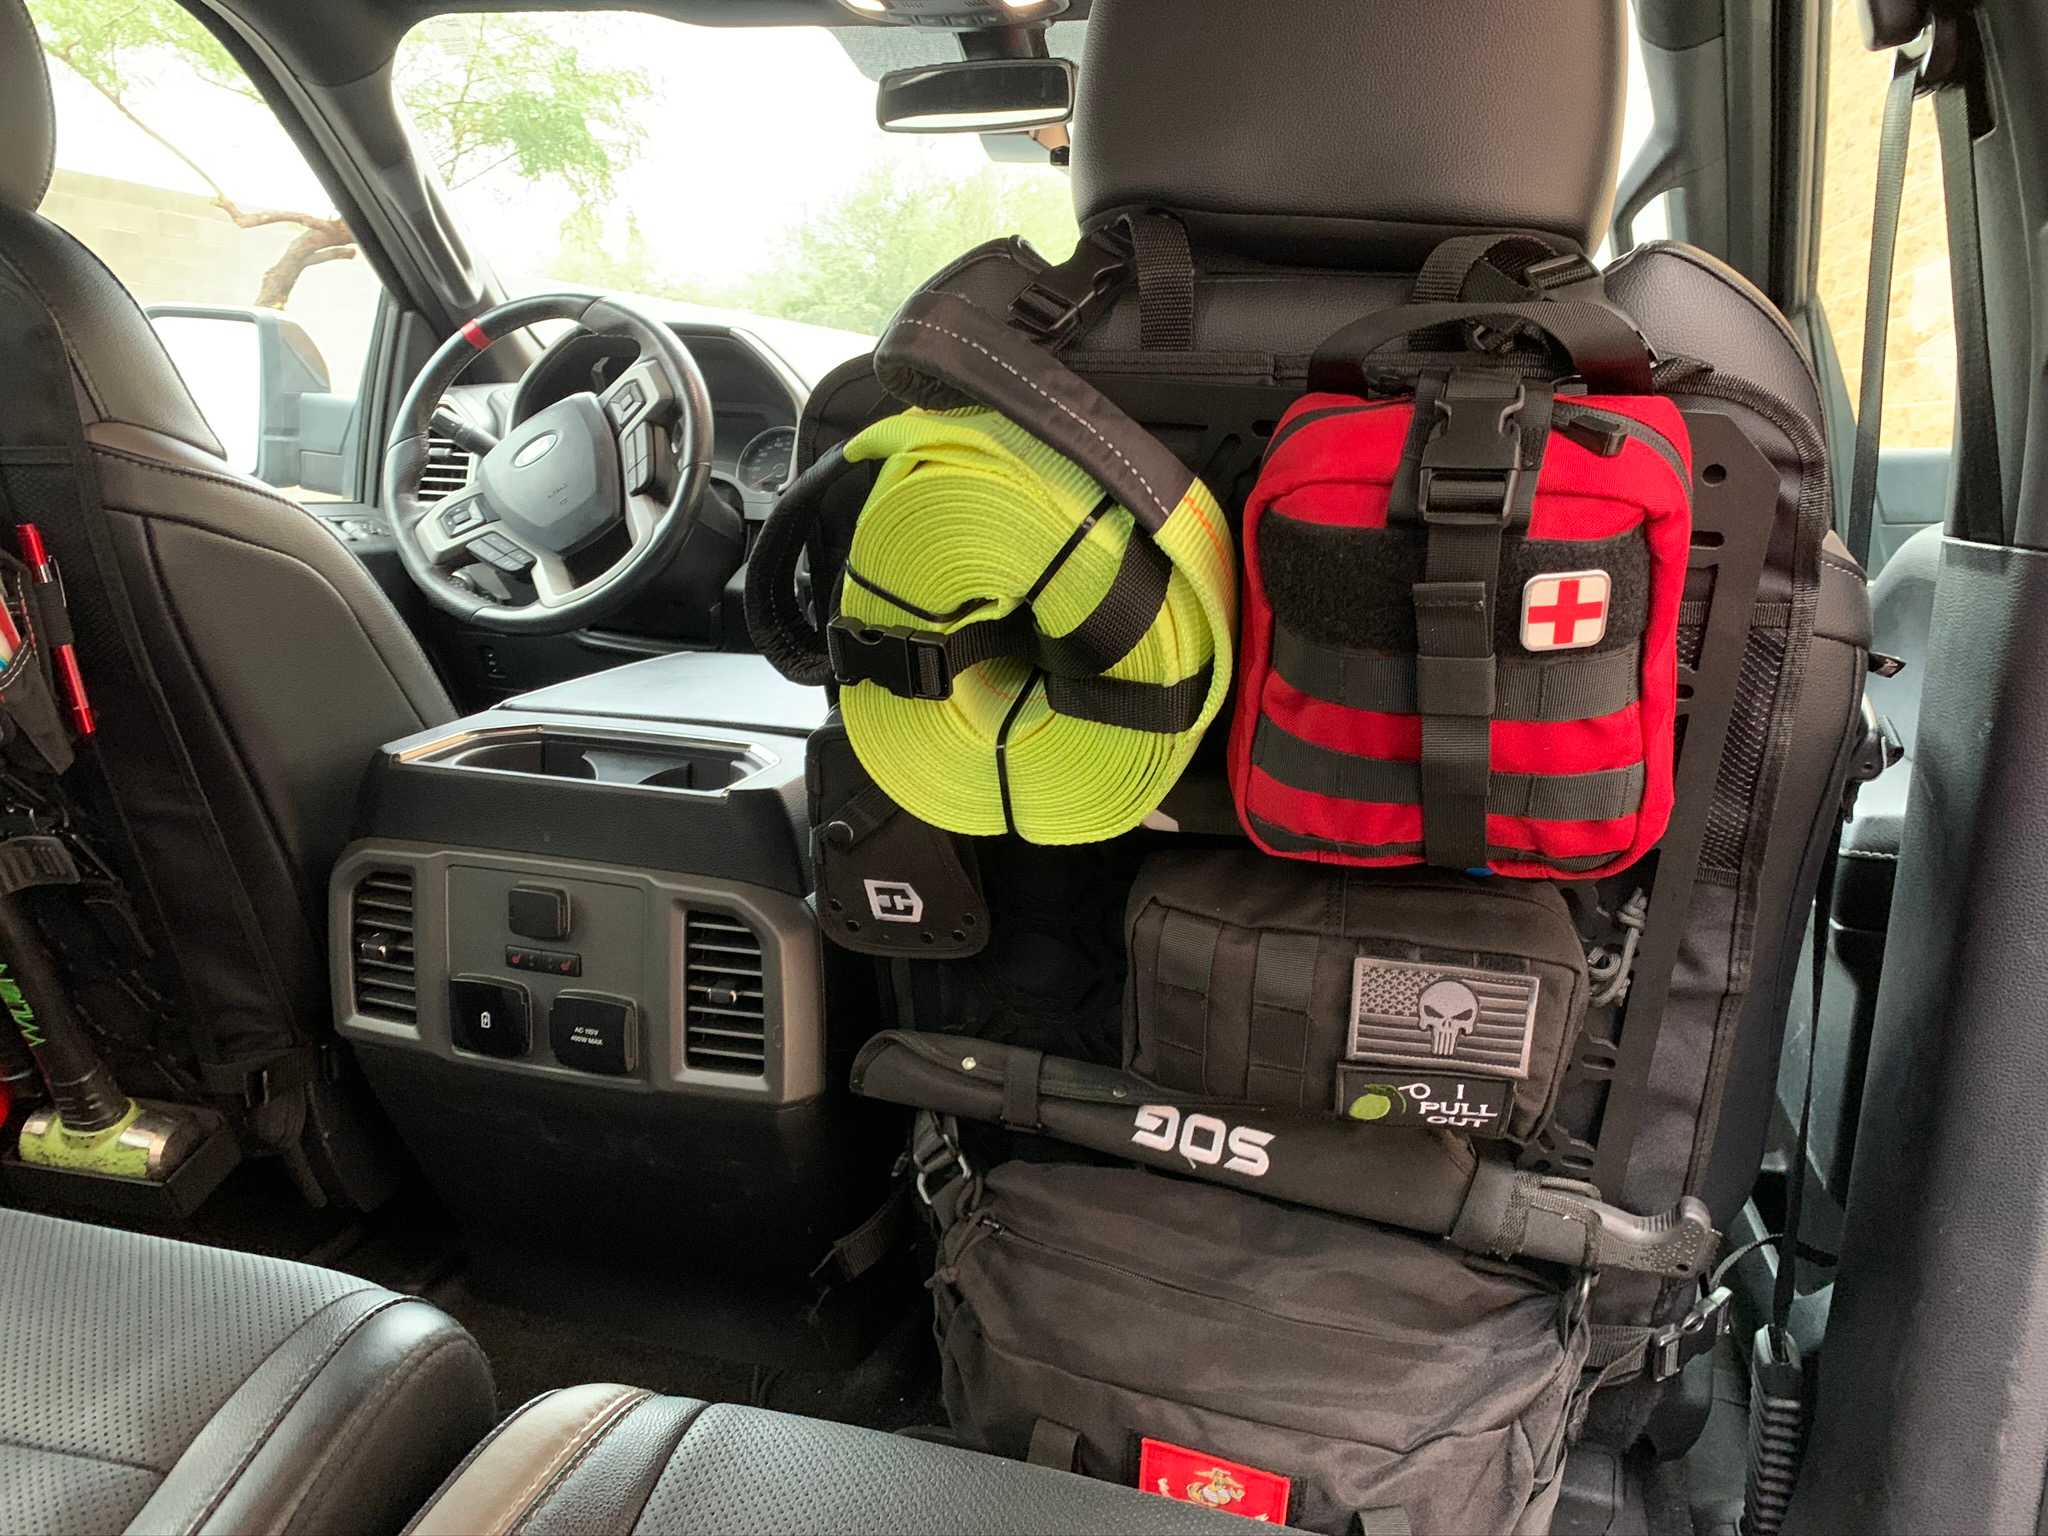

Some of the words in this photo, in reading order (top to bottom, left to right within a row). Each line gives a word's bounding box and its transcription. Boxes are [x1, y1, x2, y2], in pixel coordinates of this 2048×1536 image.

[1456, 1083, 1465, 1100] I
[1418, 1101, 1498, 1117] PULL
[1426, 1115, 1489, 1128] OUT
